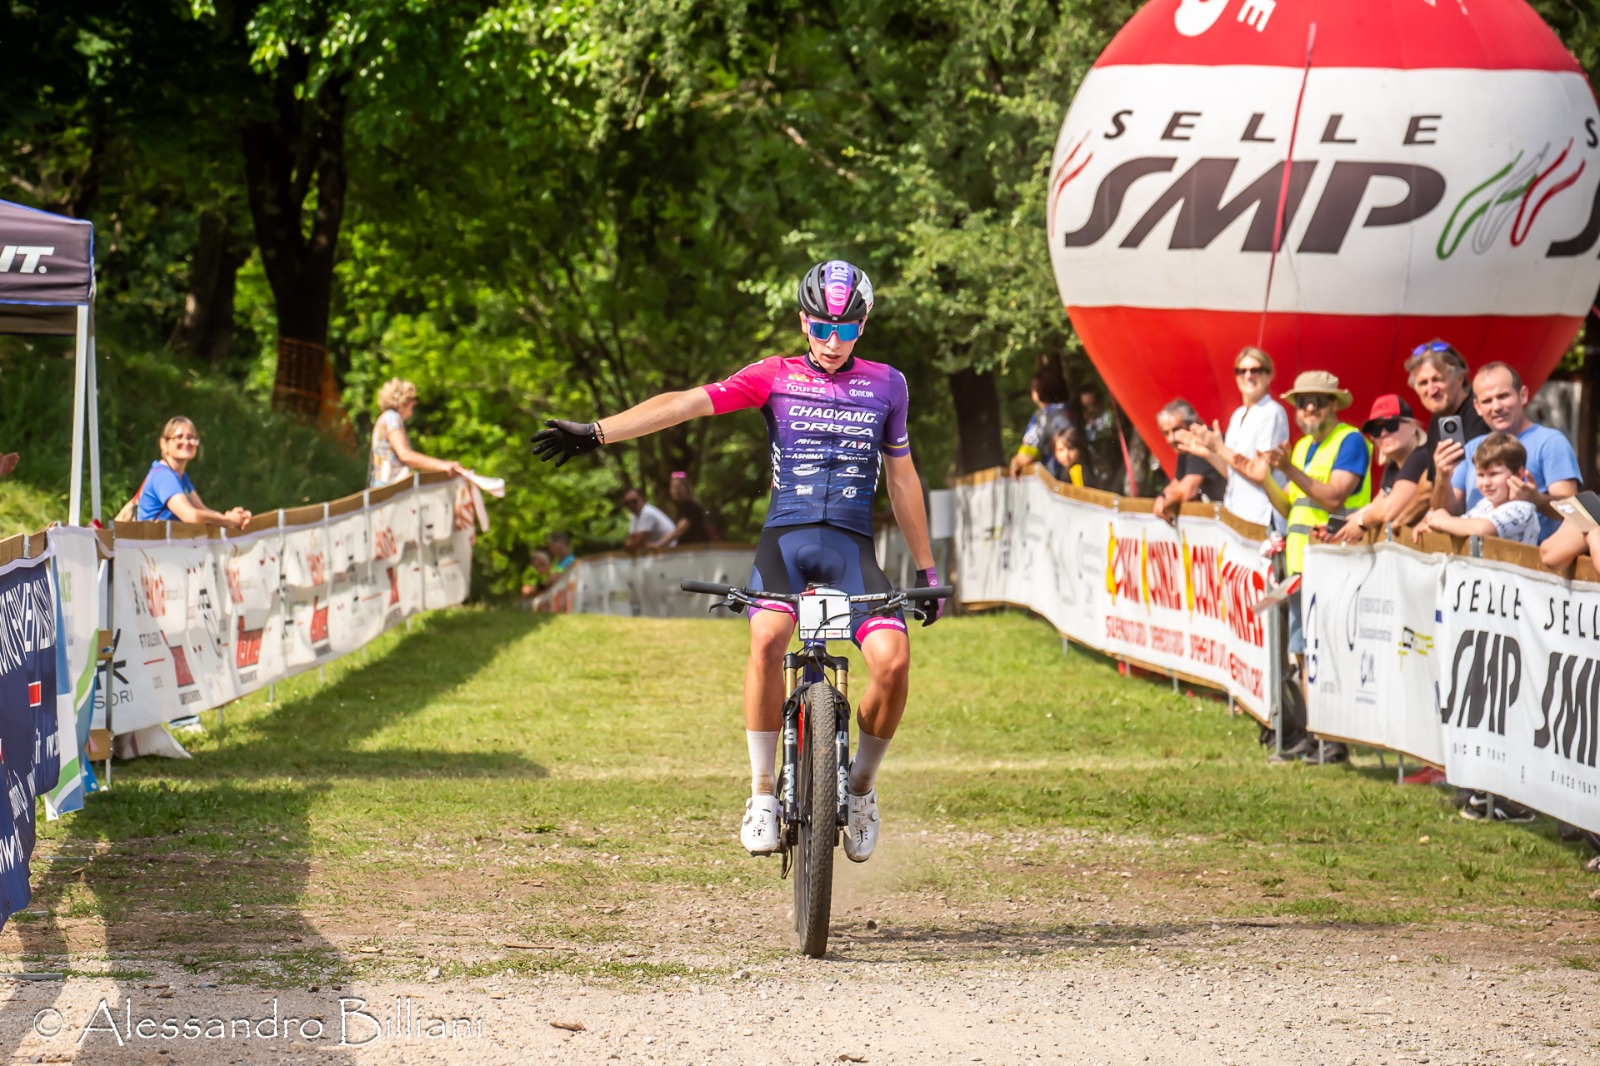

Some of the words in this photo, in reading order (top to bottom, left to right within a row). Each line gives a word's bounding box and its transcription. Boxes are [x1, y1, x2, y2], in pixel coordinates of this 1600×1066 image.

[1104, 109, 1443, 145] SELLE
[1064, 156, 1446, 254] SMP
[790, 421, 874, 437] ORBEA
[819, 598, 831, 626] 1
[1453, 579, 1522, 620] SELLE
[1441, 629, 1522, 737] SMP
